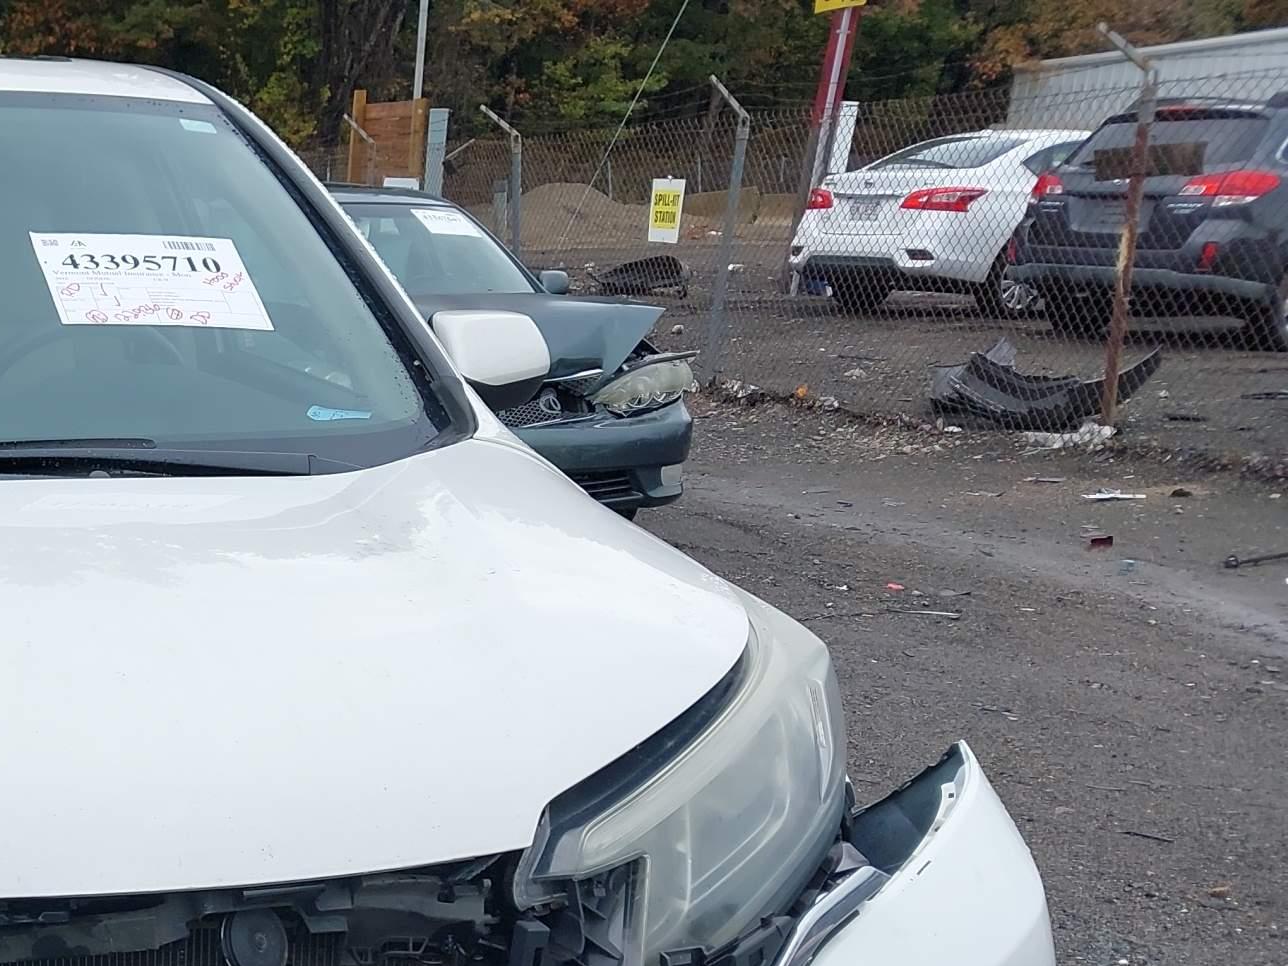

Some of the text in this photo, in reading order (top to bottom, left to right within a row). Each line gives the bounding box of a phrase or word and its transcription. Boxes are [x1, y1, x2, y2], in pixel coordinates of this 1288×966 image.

[654, 193, 680, 206] SPILL-KIT
[654, 210, 676, 224] STATION
[62, 253, 221, 273] 43395710
